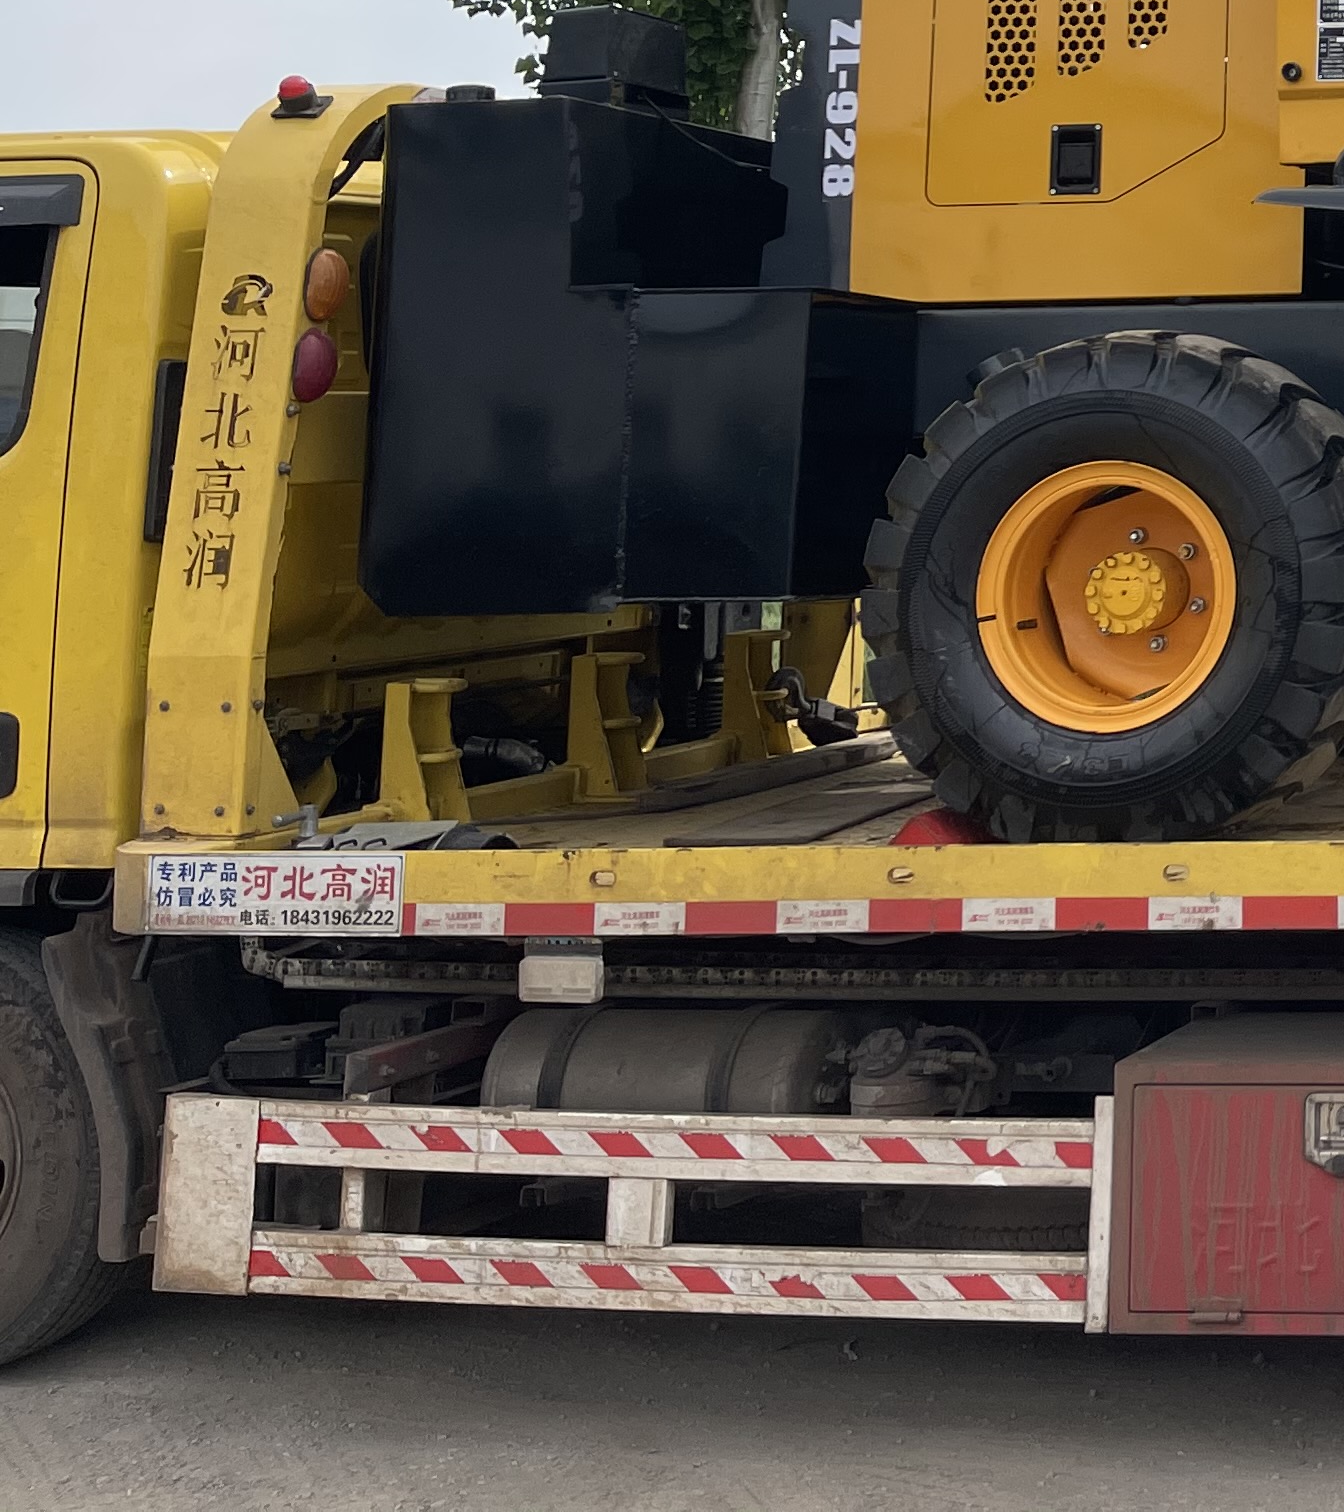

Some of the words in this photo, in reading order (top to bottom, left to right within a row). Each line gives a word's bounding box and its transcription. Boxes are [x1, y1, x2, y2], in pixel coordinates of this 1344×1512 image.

[822, 19, 862, 197] ZL-928
[183, 324, 266, 590] 河北高润
[156, 861, 238, 883] 专利产品
[241, 863, 396, 902] 河北高润
[156, 886, 238, 908] 仿冒必究
